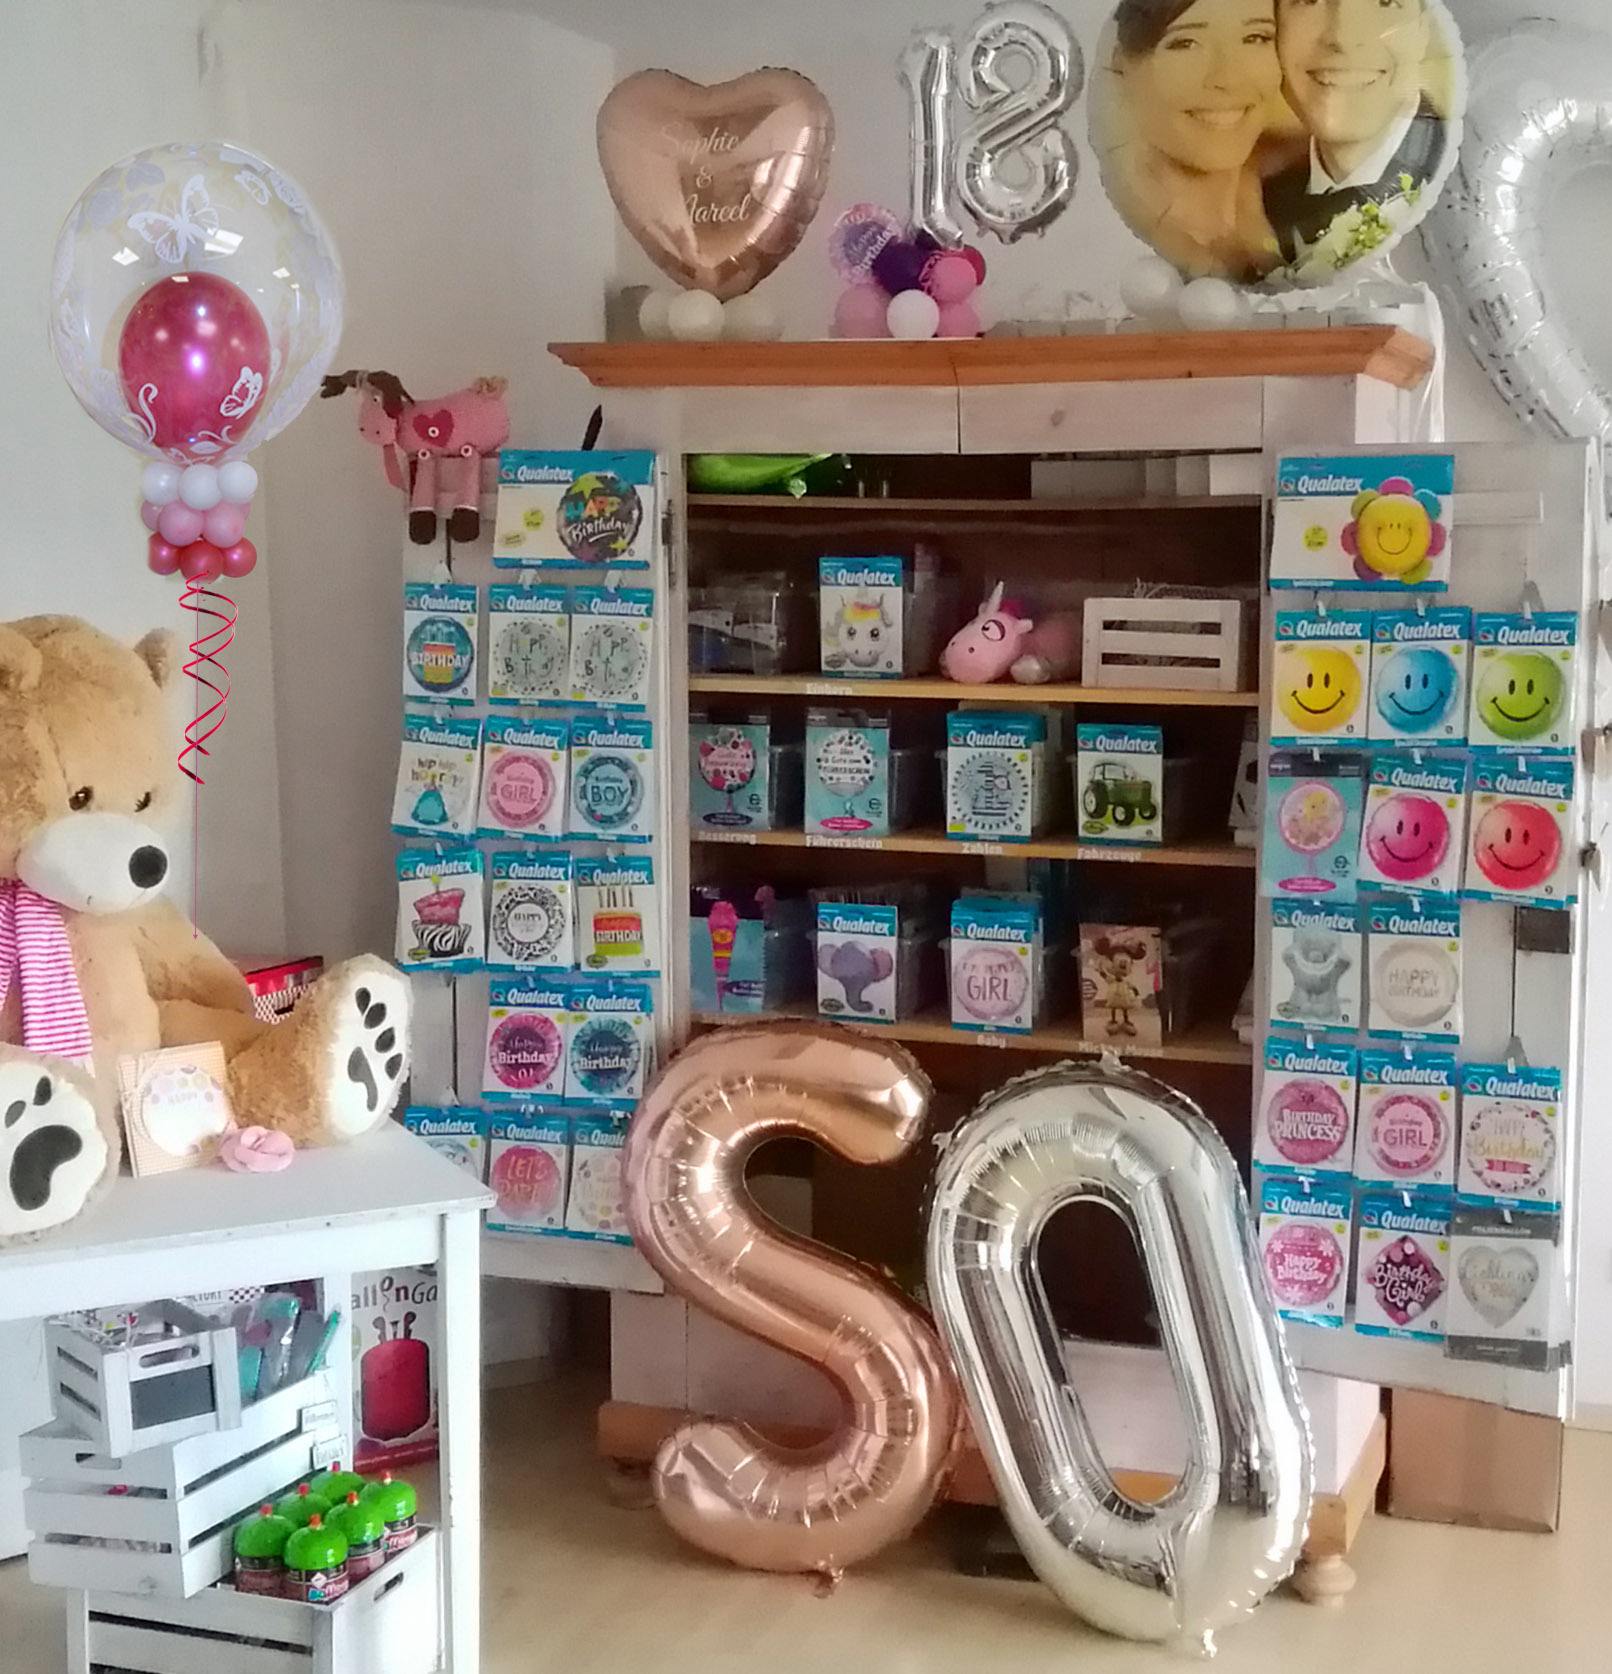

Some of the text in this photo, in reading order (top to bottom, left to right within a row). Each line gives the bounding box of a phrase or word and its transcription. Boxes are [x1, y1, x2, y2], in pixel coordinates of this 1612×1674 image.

[662, 123, 740, 165] Sophie
[696, 165, 713, 188] &
[517, 465, 574, 482] Qualatex
[1298, 475, 1362, 493] Qualatex
[568, 516, 629, 545] Birthday
[837, 568, 896, 587] Qualatex
[420, 595, 473, 613] Qualatex
[507, 595, 563, 612] Qualatex
[591, 598, 648, 615] Qualatex
[1296, 619, 1362, 638] Qualatex
[1393, 622, 1460, 640] Qualatex
[1498, 625, 1569, 645] Qualatex
[412, 652, 468, 668] BIRTHDAY
[419, 727, 475, 748] Qualatex
[503, 727, 560, 749] Qualatex
[588, 727, 644, 749] Qualatex
[966, 730, 1026, 748] Qualatex
[1096, 735, 1157, 752] Qualatex
[1391, 767, 1456, 793] Qualatex
[1495, 776, 1567, 798] Qualatex
[500, 783, 537, 801] GIRL
[591, 785, 630, 803] BOY
[416, 859, 472, 878] Qualatex
[509, 862, 566, 879] Qualatex
[593, 868, 649, 885] Qualatex
[833, 917, 890, 936] Qualatex
[1291, 911, 1355, 932] Qualatex
[1389, 914, 1456, 938] Qualatex
[595, 930, 642, 944] BIRTHDAY
[967, 923, 1027, 942] Qualatex
[1389, 969, 1439, 986] HAPPY
[507, 988, 564, 1007] Qualatex
[967, 976, 1011, 1001] GIRL
[586, 994, 641, 1012] Qualatex
[977, 1035, 1007, 1048] Baby
[499, 1050, 551, 1065] Birthday
[579, 1056, 632, 1071] Birthday
[1284, 1053, 1349, 1076] Qualatex
[1381, 1065, 1447, 1086] Qualatex
[1486, 1076, 1555, 1101] Qualatex
[420, 1116, 477, 1134] Qualatex
[1282, 1108, 1336, 1125] BIRTHDAY
[507, 1124, 561, 1143] Qualatex
[1275, 1121, 1342, 1141] PRINCESS
[1383, 1128, 1428, 1147] GIRL
[1280, 1197, 1344, 1219] Qualatex
[1381, 1209, 1448, 1234] Qualatex
[1284, 1253, 1322, 1271] Happy
[1277, 1265, 1328, 1284] Birthday
[1375, 1263, 1436, 1292] Birthday
[1386, 1279, 1426, 1307] Girl
